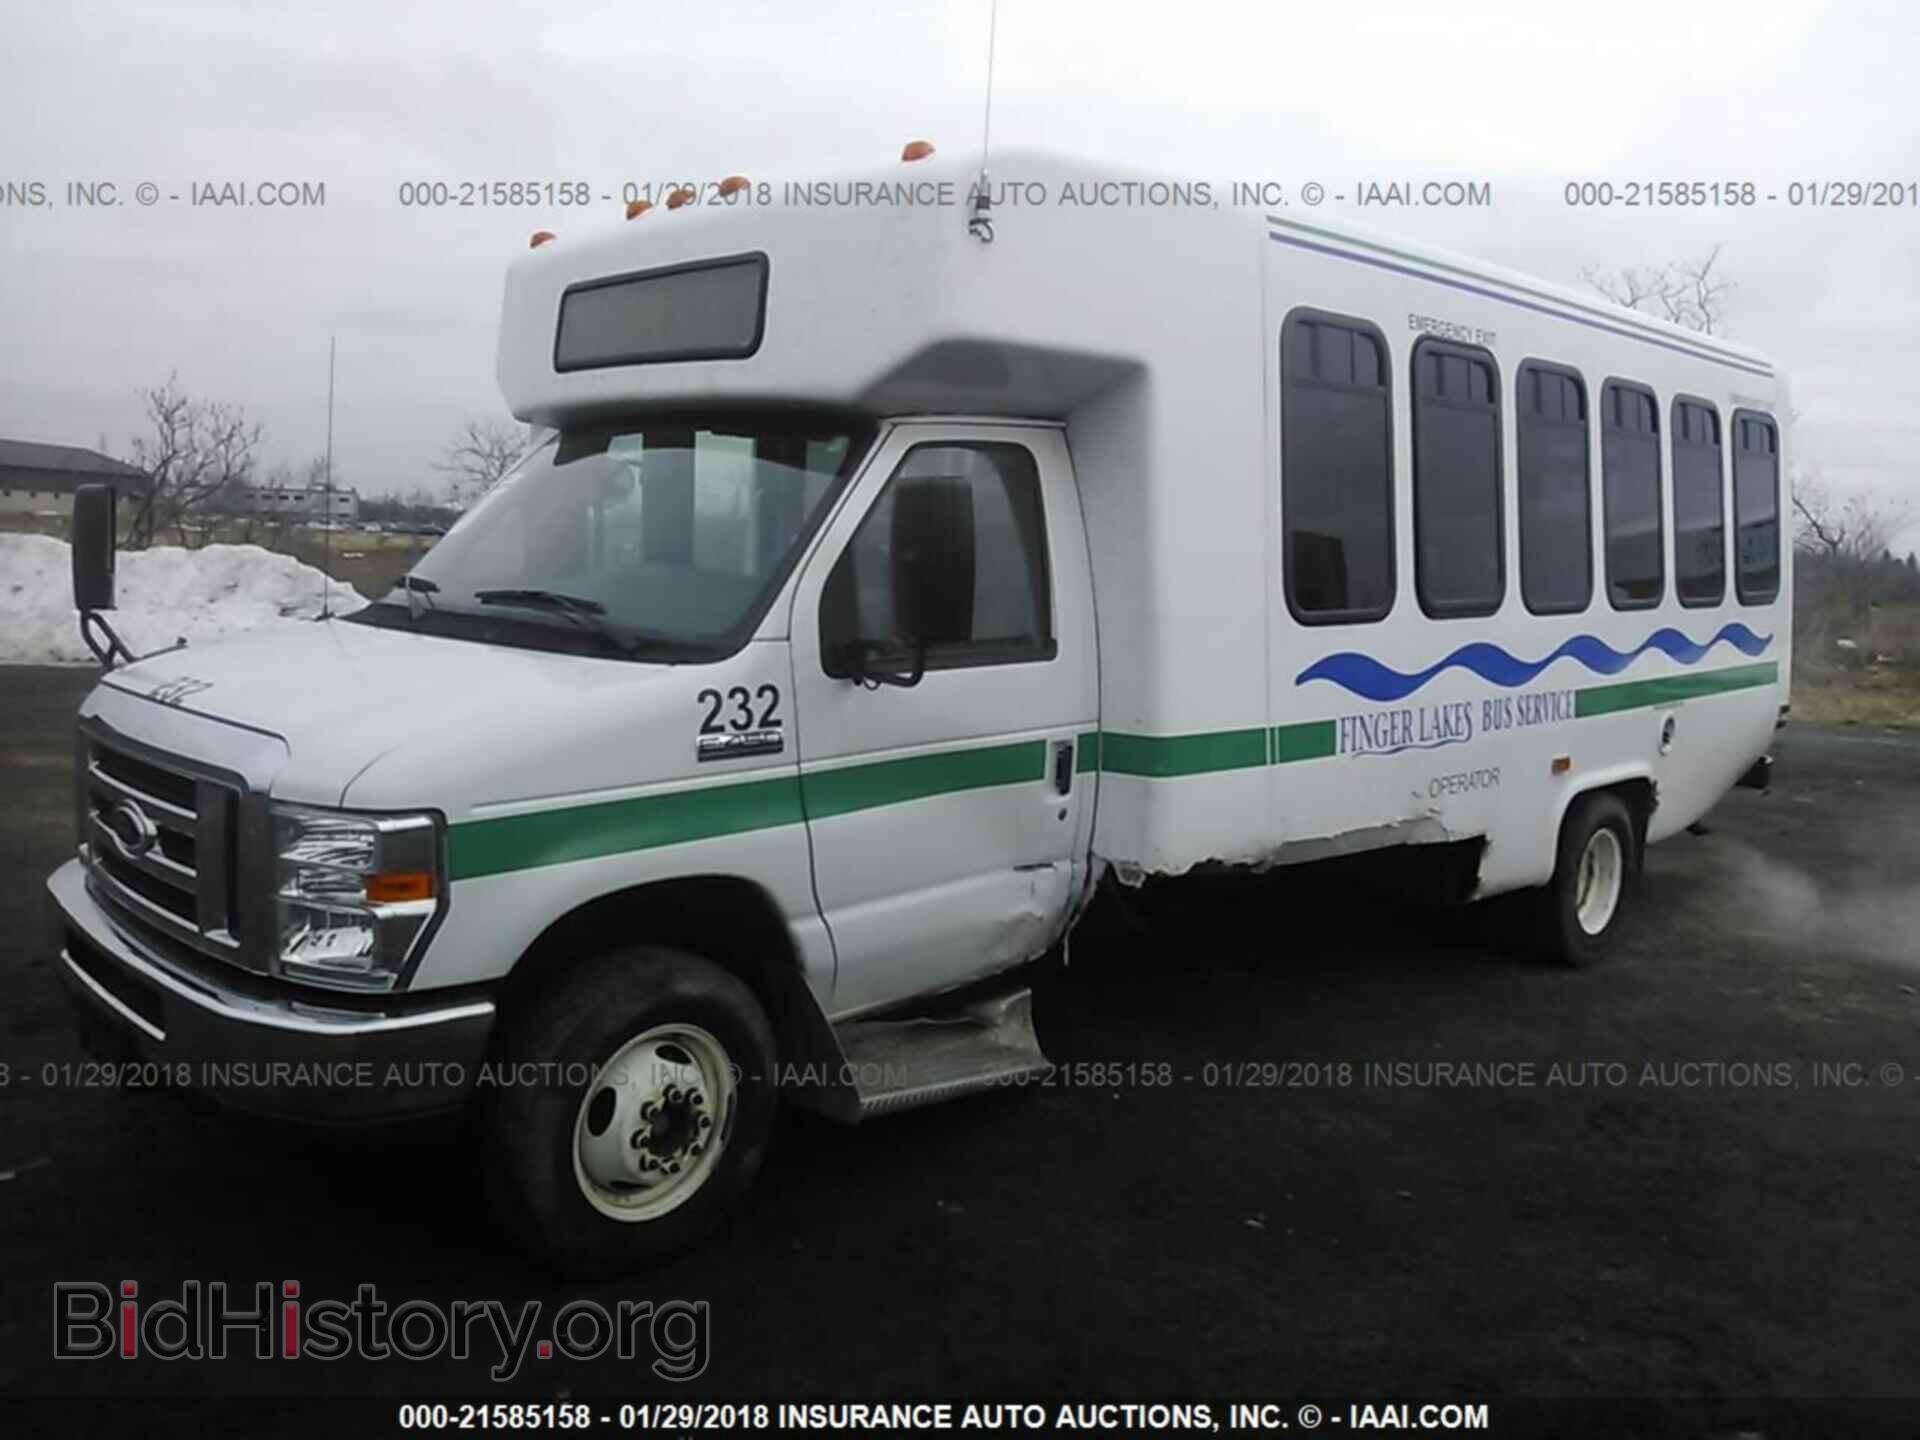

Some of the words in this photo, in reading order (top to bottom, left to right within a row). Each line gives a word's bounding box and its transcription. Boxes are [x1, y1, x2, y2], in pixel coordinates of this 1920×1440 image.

[1408, 312, 1473, 343] EMERGENCY
[697, 683, 782, 735] 232
[1339, 709, 1414, 754] FINGER
[1419, 701, 1473, 743] LAKES
[1481, 696, 1515, 732] BUS
[1516, 689, 1575, 727] SERVICE
[1428, 767, 1501, 799] OPERATOR
